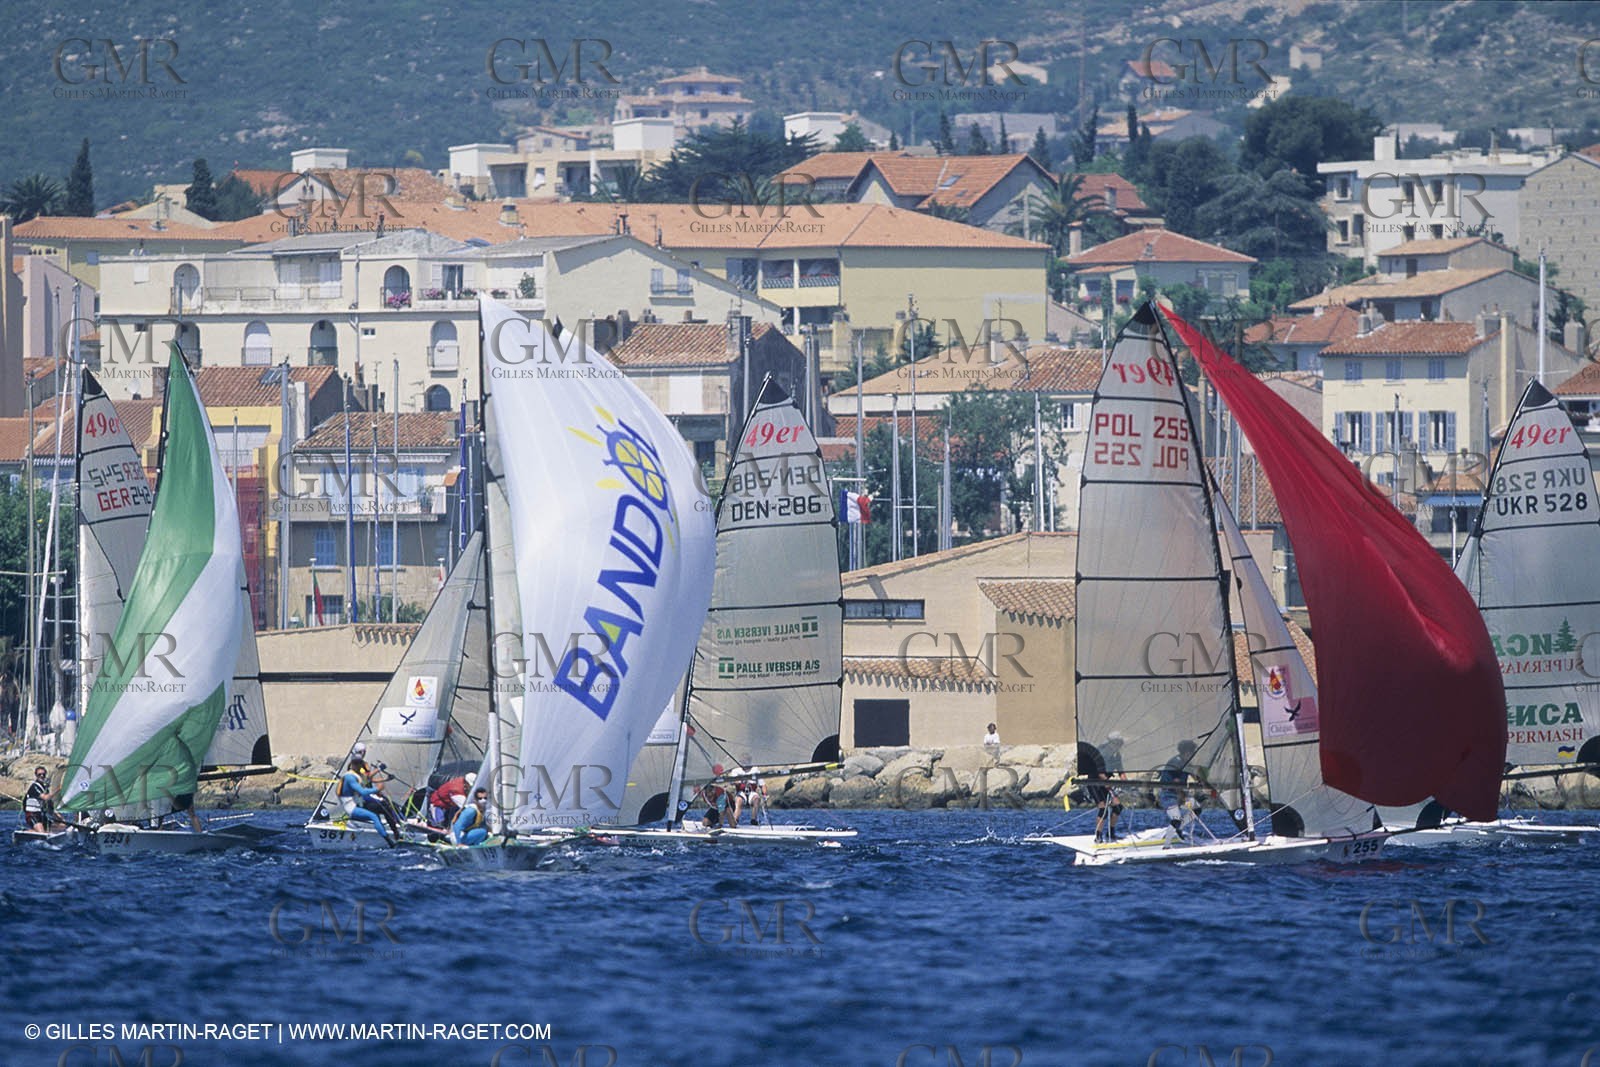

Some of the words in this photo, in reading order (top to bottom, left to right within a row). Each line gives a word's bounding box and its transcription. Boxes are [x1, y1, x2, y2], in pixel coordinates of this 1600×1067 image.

[745, 422, 805, 448] 49er
[1095, 413, 1141, 437] POL
[1153, 416, 1189, 442] 255
[1510, 424, 1571, 449] 49er
[97, 488, 132, 512] GER
[130, 486, 152, 506] 242
[732, 495, 822, 522] DEN-286
[1497, 495, 1539, 516] UKR
[1544, 492, 1588, 513] 528
[736, 662, 763, 673] PALLE
[765, 661, 802, 673] IVERSEN
[804, 659, 821, 670] A/S
[1508, 728, 1584, 744] PERMASH
[319, 829, 345, 840] 361
[1353, 839, 1378, 854] 255
